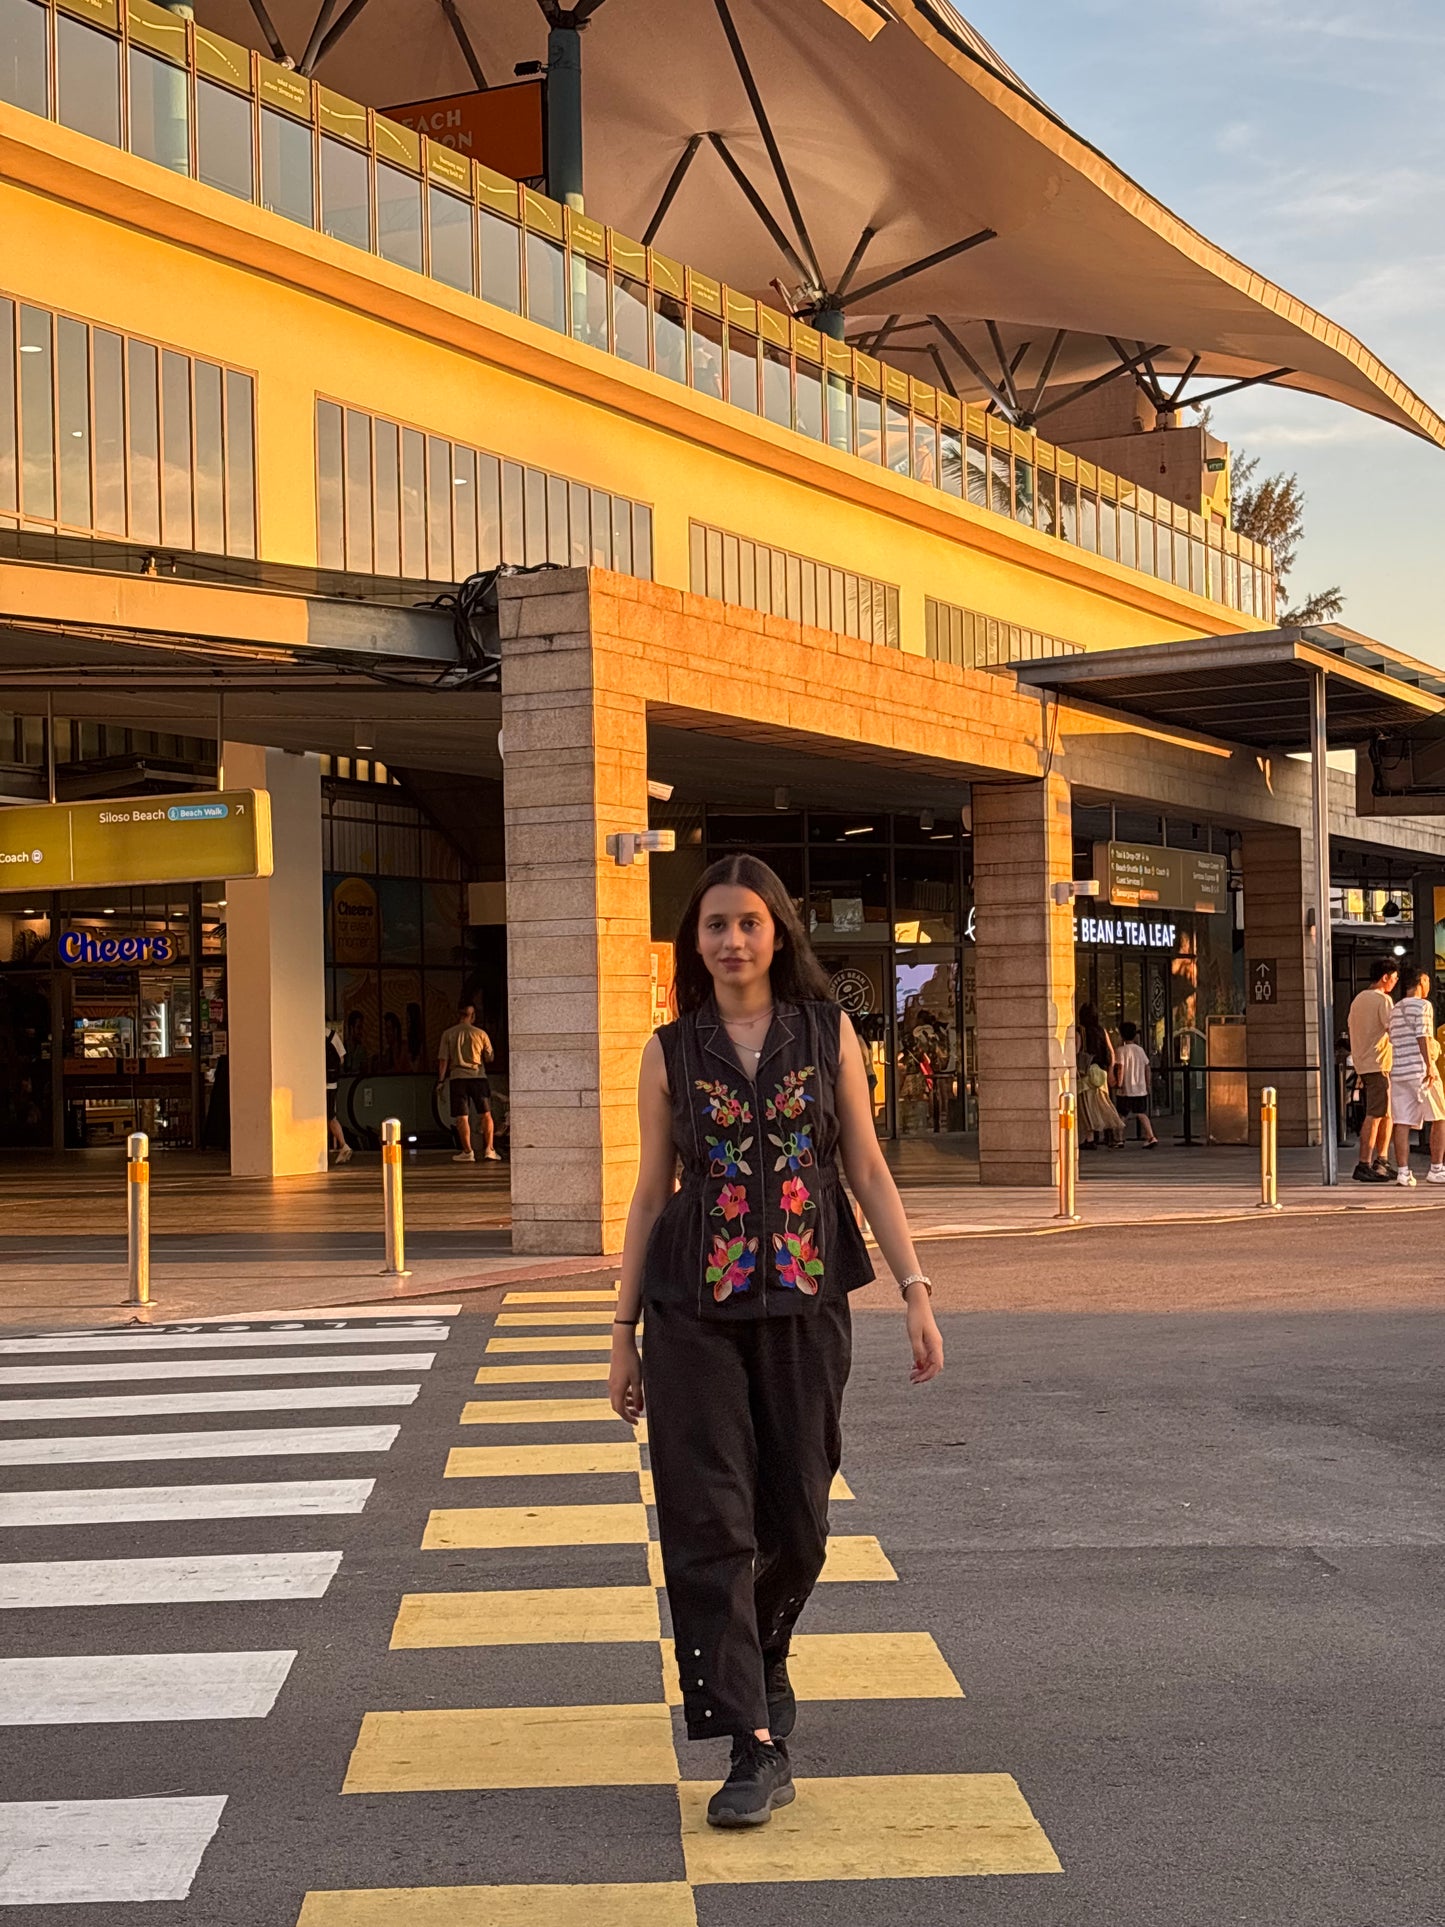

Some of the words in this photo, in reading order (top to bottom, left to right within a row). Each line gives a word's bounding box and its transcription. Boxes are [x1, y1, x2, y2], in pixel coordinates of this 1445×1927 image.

[99, 811, 130, 824] Siloso
[132, 809, 165, 822] Beach
[180, 808, 202, 818] Beach
[204, 807, 223, 816] Walk
[0, 851, 29, 864] Coach
[338, 901, 373, 916] Cheers
[1081, 918, 1114, 943] BEAN
[1116, 921, 1124, 944] &
[1124, 921, 1147, 946] TEA
[1149, 923, 1176, 947] LEAF
[59, 931, 172, 963] Cheers
[847, 972, 867, 985] BEAN
